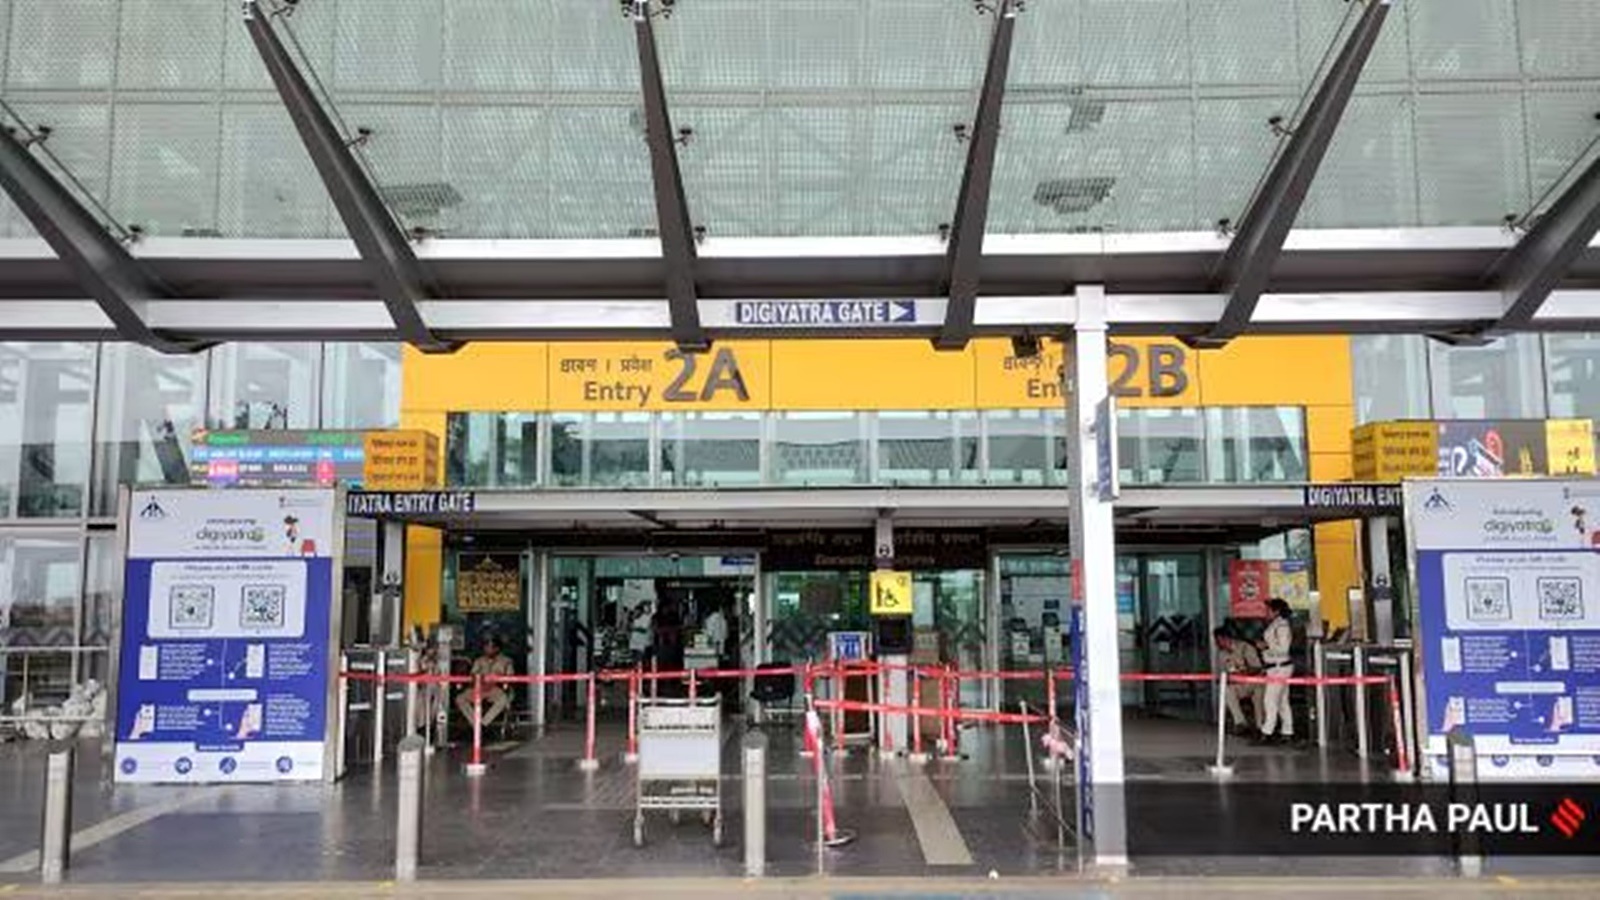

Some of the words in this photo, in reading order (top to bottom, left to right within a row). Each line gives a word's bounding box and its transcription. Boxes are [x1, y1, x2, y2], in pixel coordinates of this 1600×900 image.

[741, 302, 833, 323] DIGIYATRA
[838, 302, 886, 321] GATE
[662, 347, 750, 401] 2A
[1108, 344, 1188, 397] 2B
[584, 381, 651, 407] Entry
[394, 493, 436, 513] ENTRY
[438, 492, 471, 513] GATE
